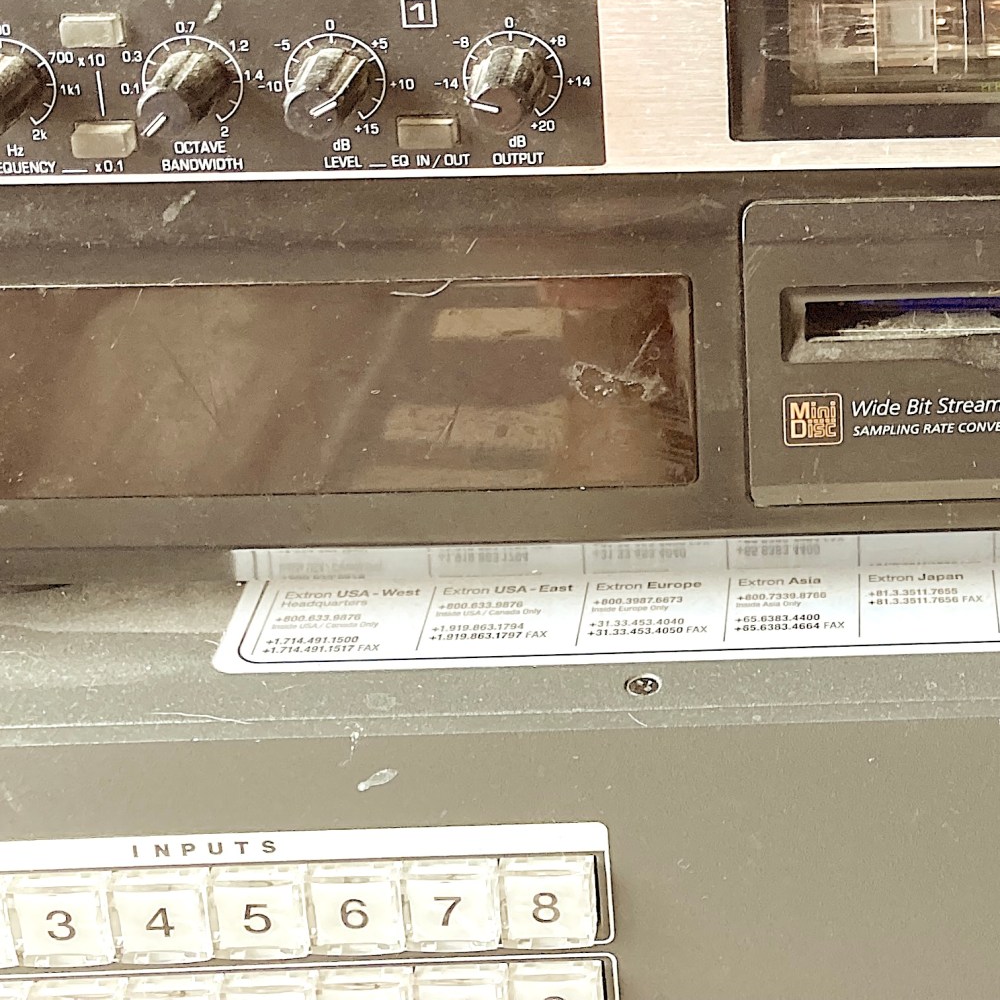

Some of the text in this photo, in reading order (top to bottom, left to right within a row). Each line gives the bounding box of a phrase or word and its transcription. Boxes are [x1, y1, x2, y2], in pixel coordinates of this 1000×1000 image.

[410, 2, 425, 22] 1
[174, 141, 226, 154] OCTAVE
[509, 135, 526, 148] dB
[162, 158, 244, 172] BANDWIDTH
[324, 156, 362, 168] LEVEL
[391, 155, 410, 168] EQ
[493, 152, 544, 165] OUTPUT
[790, 401, 837, 419] Mini
[851, 398, 900, 417] Wide
[907, 398, 932, 415] Bit
[790, 419, 837, 439] Disc
[853, 424, 919, 437] SAMPLING
[923, 422, 954, 434] RATE
[647, 581, 702, 589] Europe
[868, 573, 964, 583] Extron Japan
[285, 591, 332, 599] Extron
[337, 590, 369, 598] USA
[443, 587, 490, 595] Extron
[538, 584, 574, 592] East
[132, 841, 277, 858] INPUTS
[339, 899, 370, 930] 6
[432, 895, 462, 926] 7
[531, 892, 561, 924] 8
[45, 909, 77, 942] 3
[145, 907, 175, 938] 4
[242, 903, 273, 934] 5
